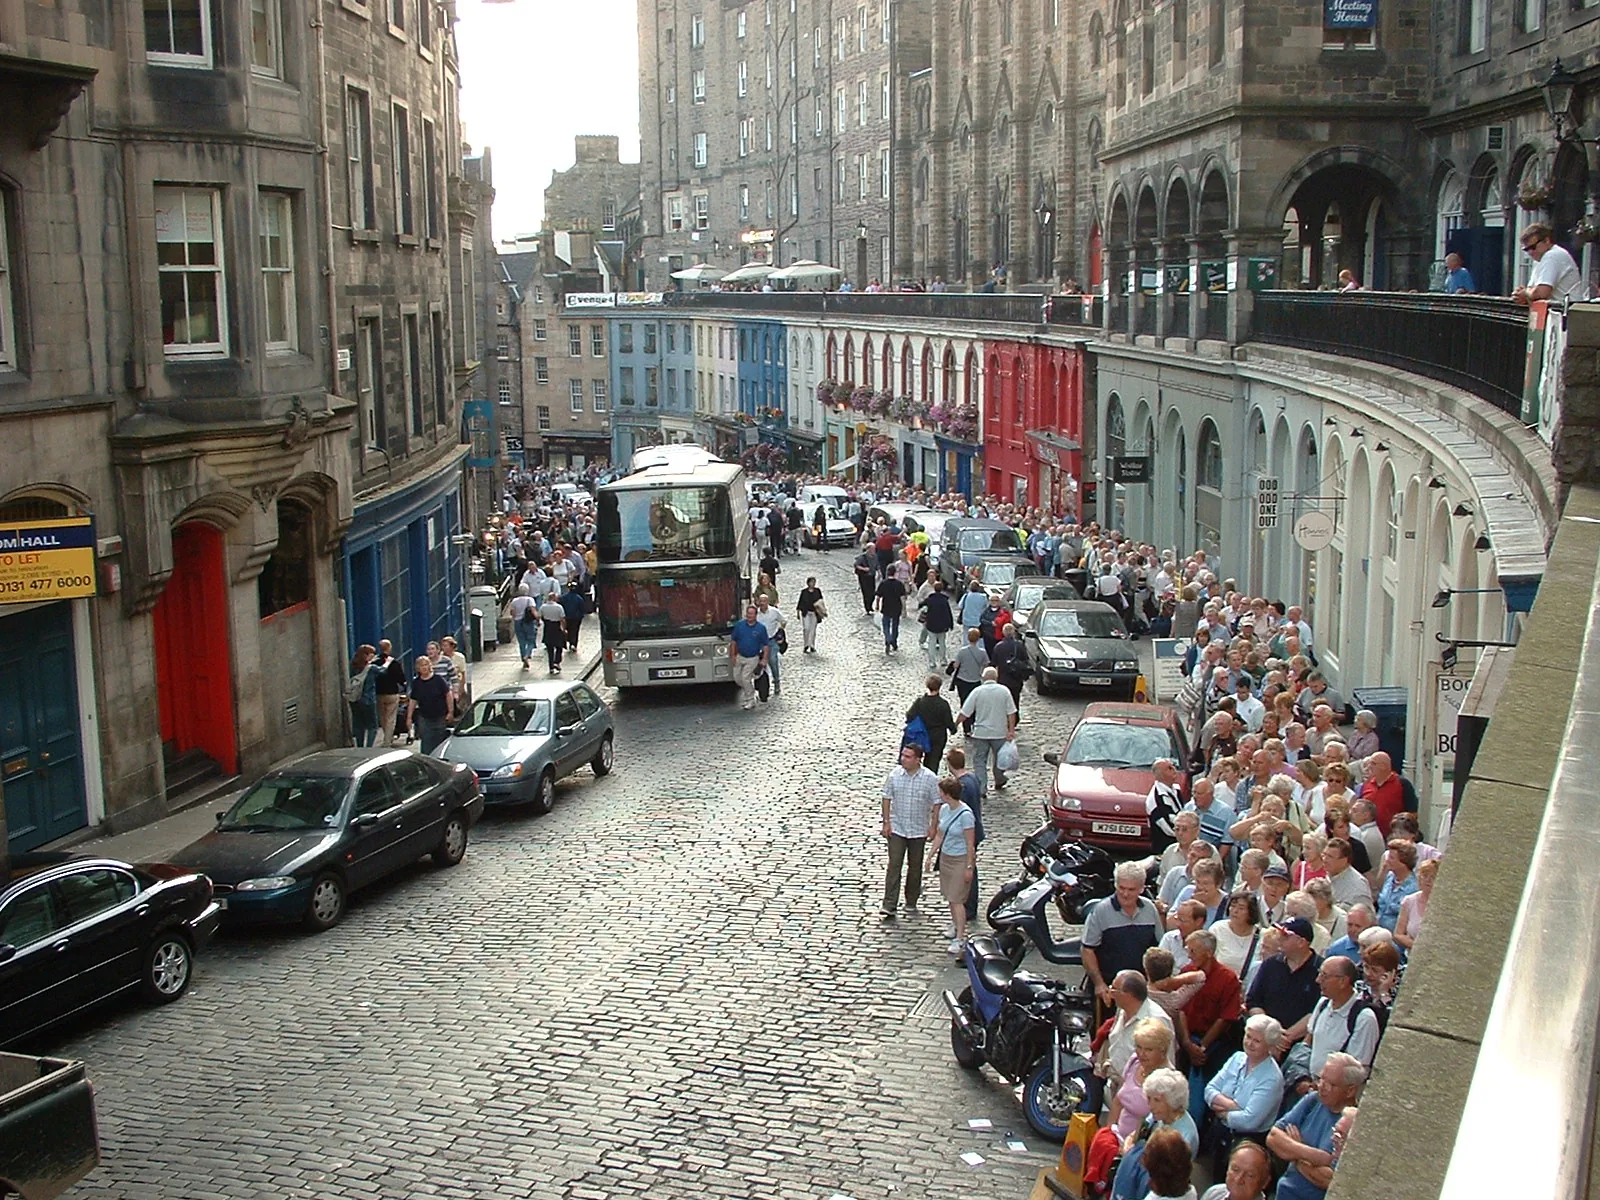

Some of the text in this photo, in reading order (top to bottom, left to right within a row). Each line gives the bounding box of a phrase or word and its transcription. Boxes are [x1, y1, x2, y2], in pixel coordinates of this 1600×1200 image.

[1329, 0, 1373, 13] Meeting
[1333, 11, 1368, 23] House
[1259, 505, 1277, 515] ONE
[1259, 516, 1277, 526] OUT
[20, 535, 60, 547] HALL
[19, 553, 41, 565] LET
[0, 576, 91, 593] 0131 477 6000
